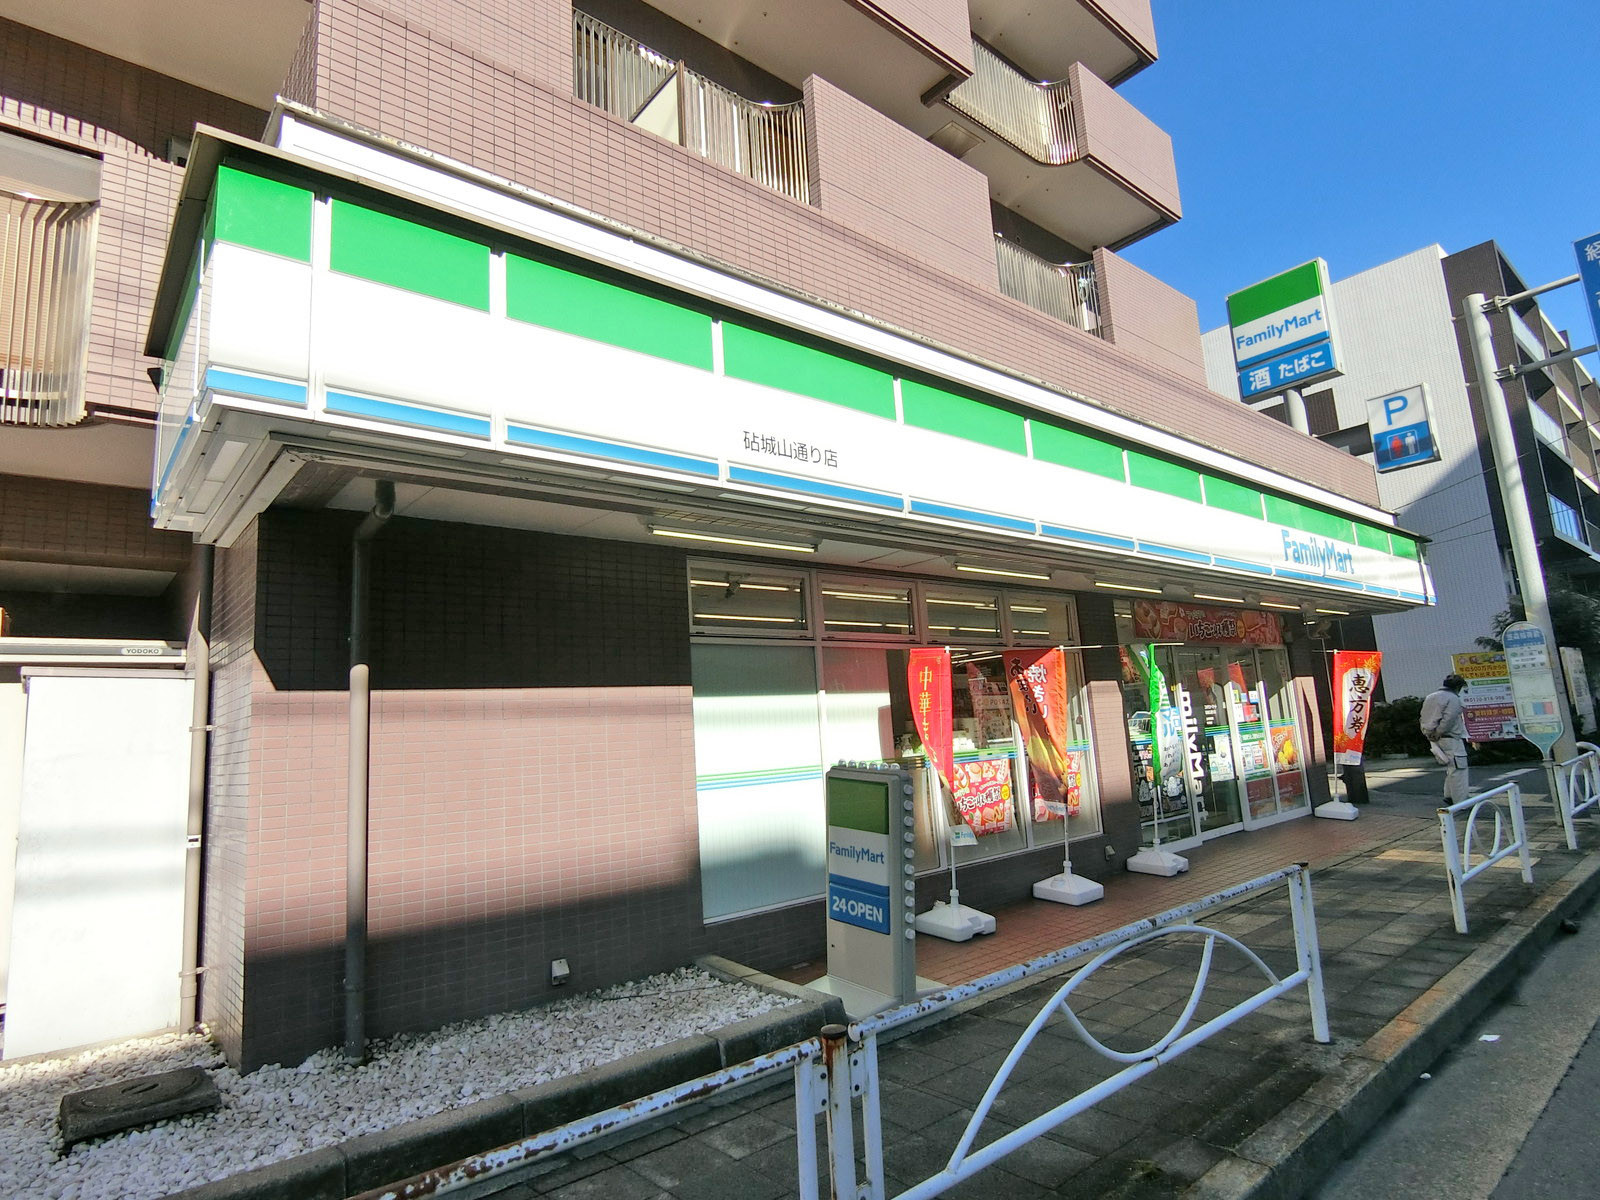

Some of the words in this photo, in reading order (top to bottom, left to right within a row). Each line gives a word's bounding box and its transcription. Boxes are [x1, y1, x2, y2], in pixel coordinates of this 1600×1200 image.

[1236, 309, 1322, 350] FamilyMart
[1249, 366, 1271, 391] 酒
[1279, 351, 1325, 379] たばこ
[1383, 396, 1409, 426] P
[743, 431, 838, 468] 砧城山通り店
[1281, 529, 1354, 577] FamilyMart
[1349, 674, 1369, 733] 恵方巻
[829, 841, 885, 865] FamilyMart
